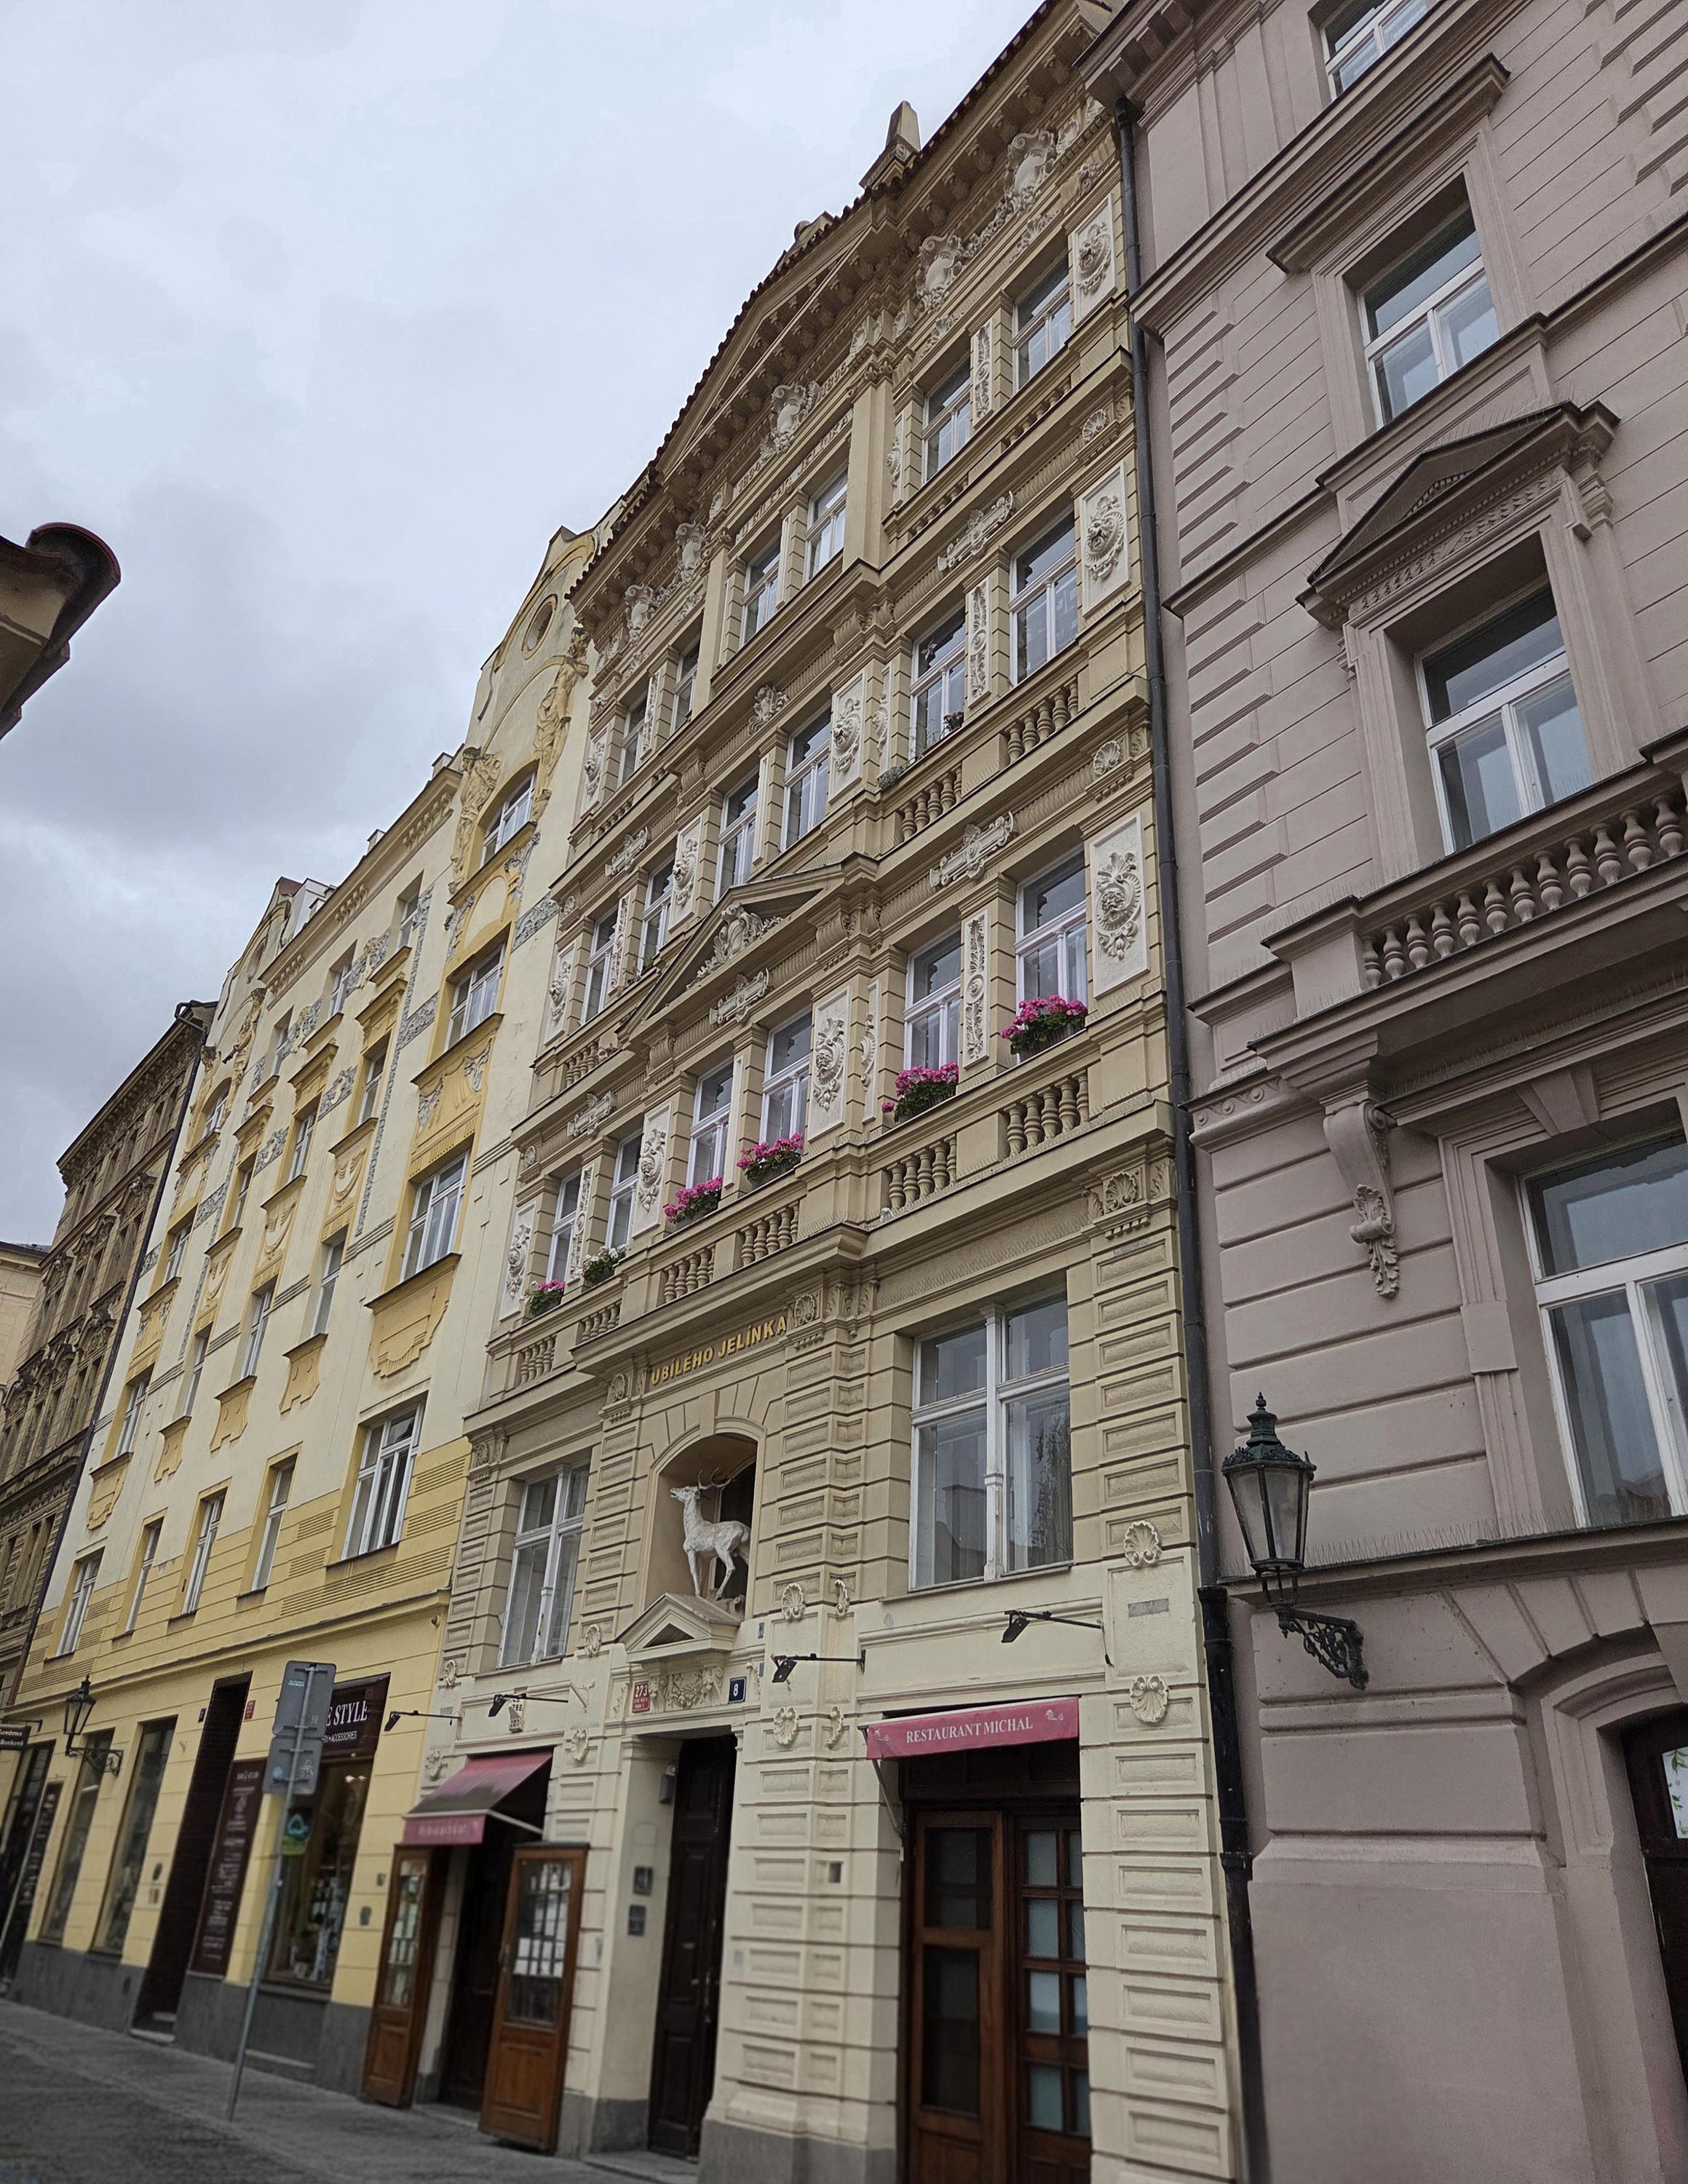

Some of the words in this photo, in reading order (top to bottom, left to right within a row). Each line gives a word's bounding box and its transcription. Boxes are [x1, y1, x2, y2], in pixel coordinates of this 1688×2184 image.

[718, 1315, 787, 1358] JELÍNKA
[635, 1685, 648, 1698] 273
[733, 1683, 739, 1697] 8
[333, 1701, 368, 1725] STYLE
[906, 1722, 982, 1744] RESTAURANT
[983, 1717, 1034, 1734] MICHAL
